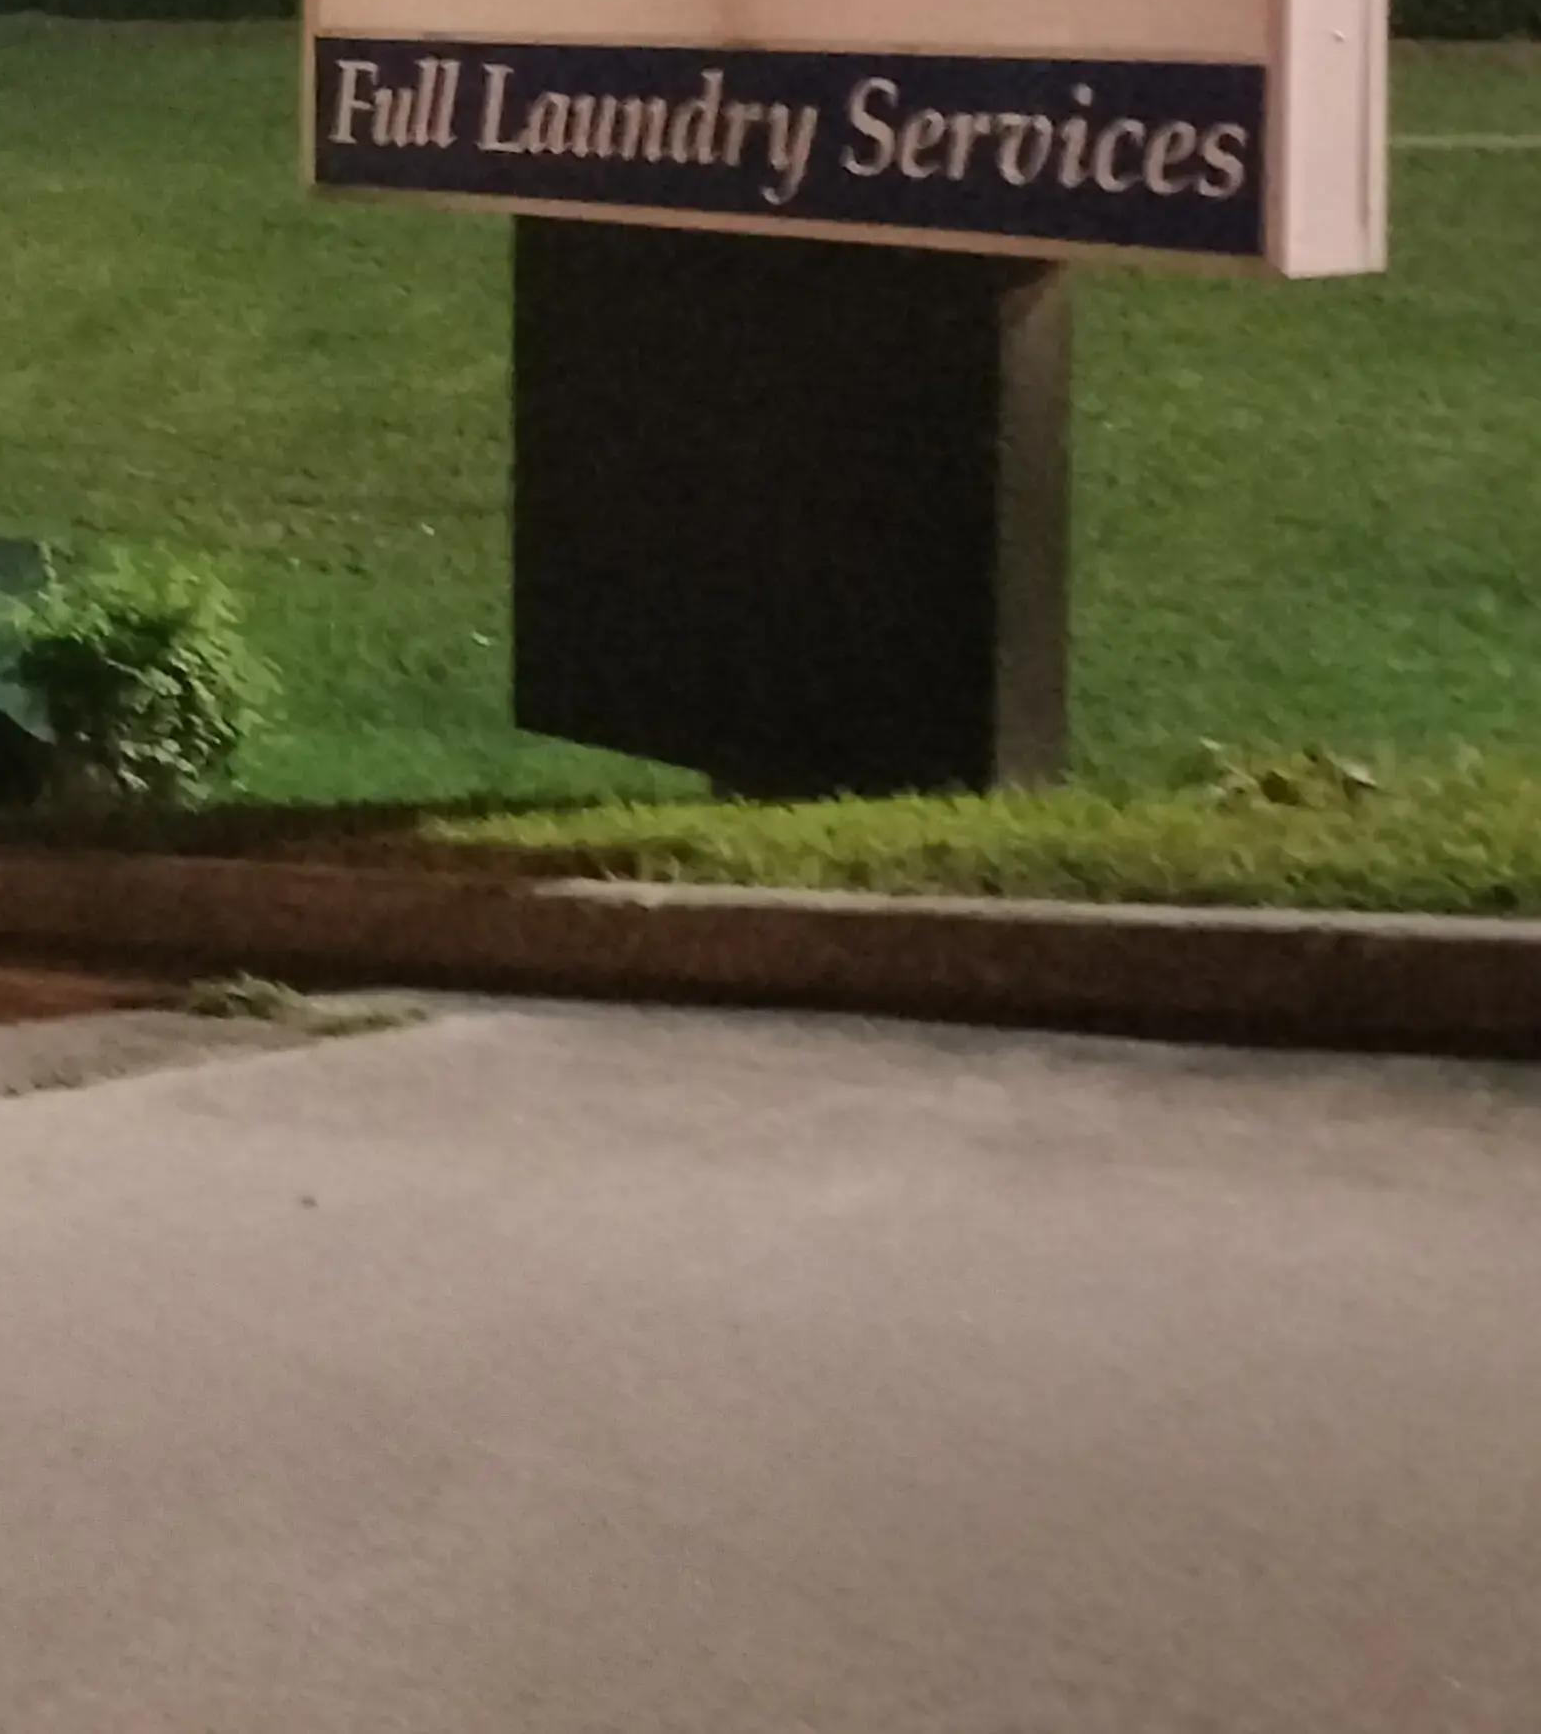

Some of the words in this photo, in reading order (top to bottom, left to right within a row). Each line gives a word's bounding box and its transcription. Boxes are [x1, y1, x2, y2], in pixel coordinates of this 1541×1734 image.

[330, 57, 462, 152] Full
[478, 65, 819, 206] Laundry
[840, 77, 1248, 199] Services
